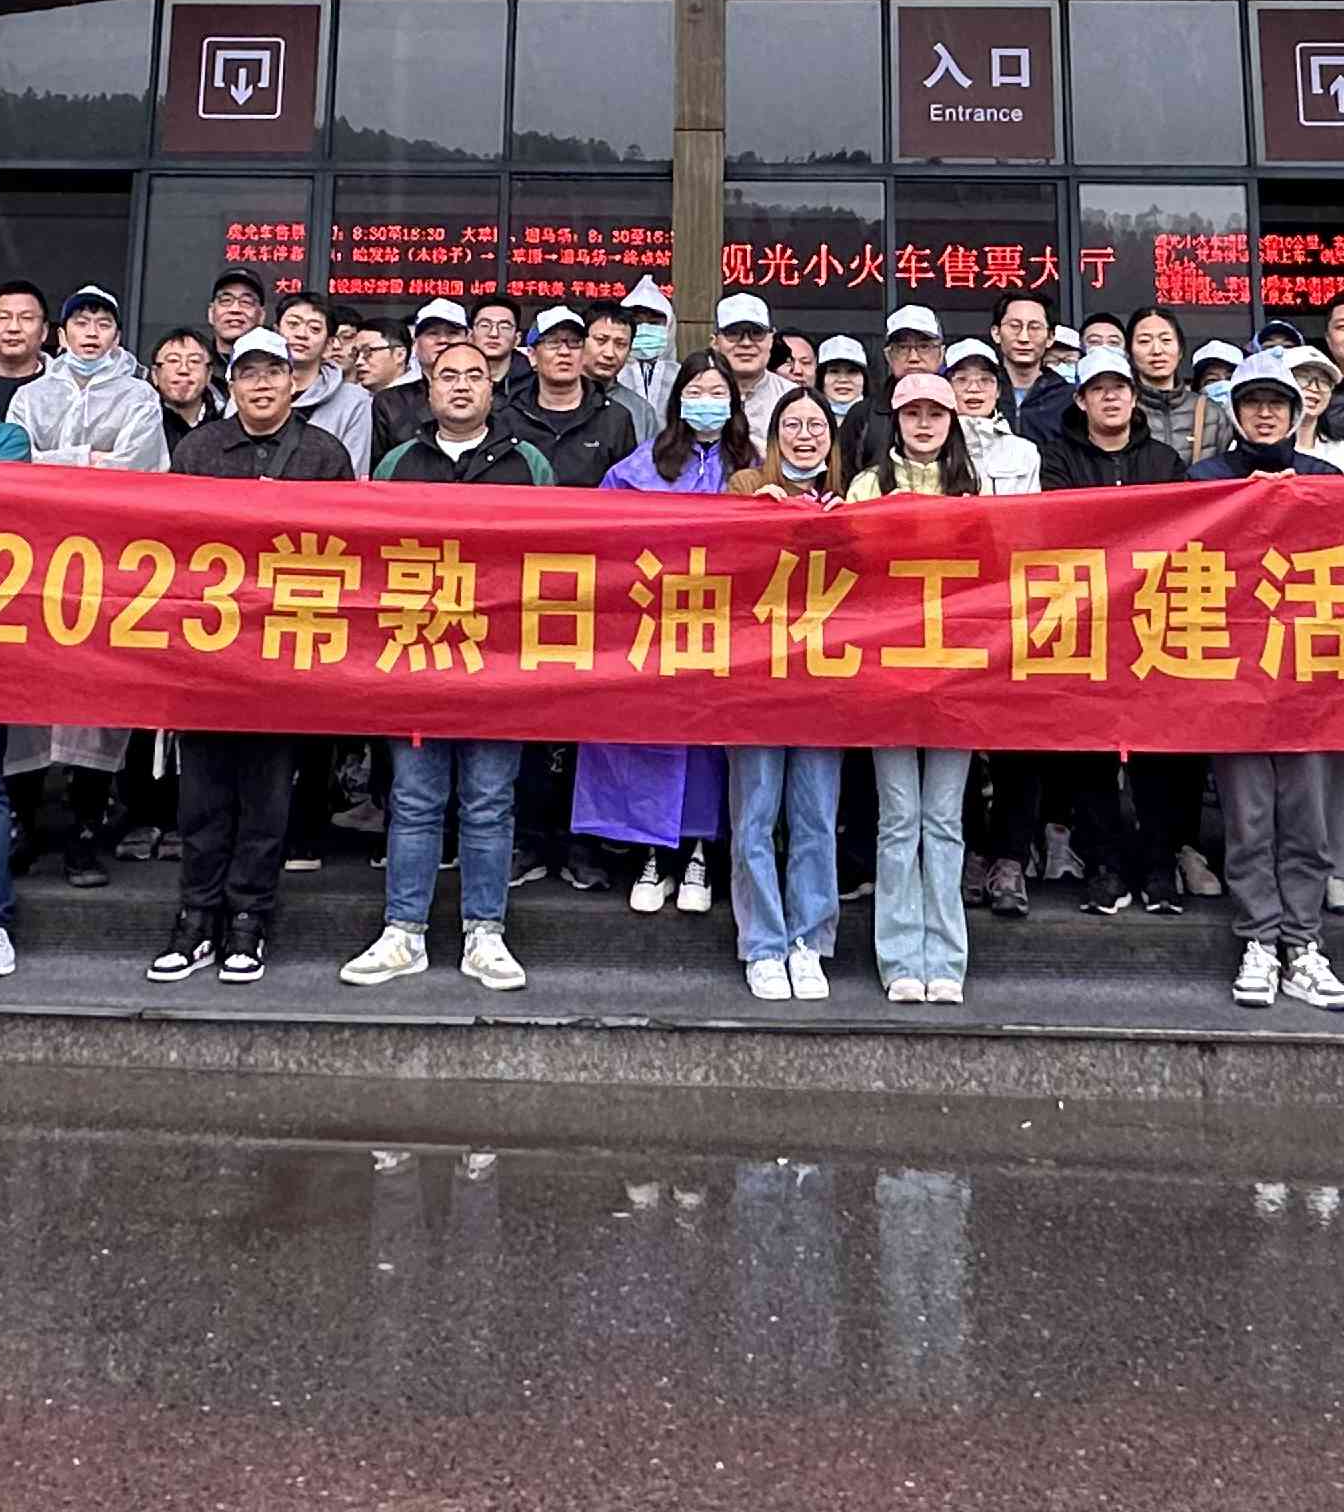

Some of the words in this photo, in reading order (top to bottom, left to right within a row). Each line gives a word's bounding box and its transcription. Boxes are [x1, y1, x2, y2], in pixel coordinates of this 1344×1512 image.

[923, 42, 1030, 88] 入口
[929, 103, 1023, 123] Entrance
[722, 242, 1116, 289] 观光小火车售票大厅
